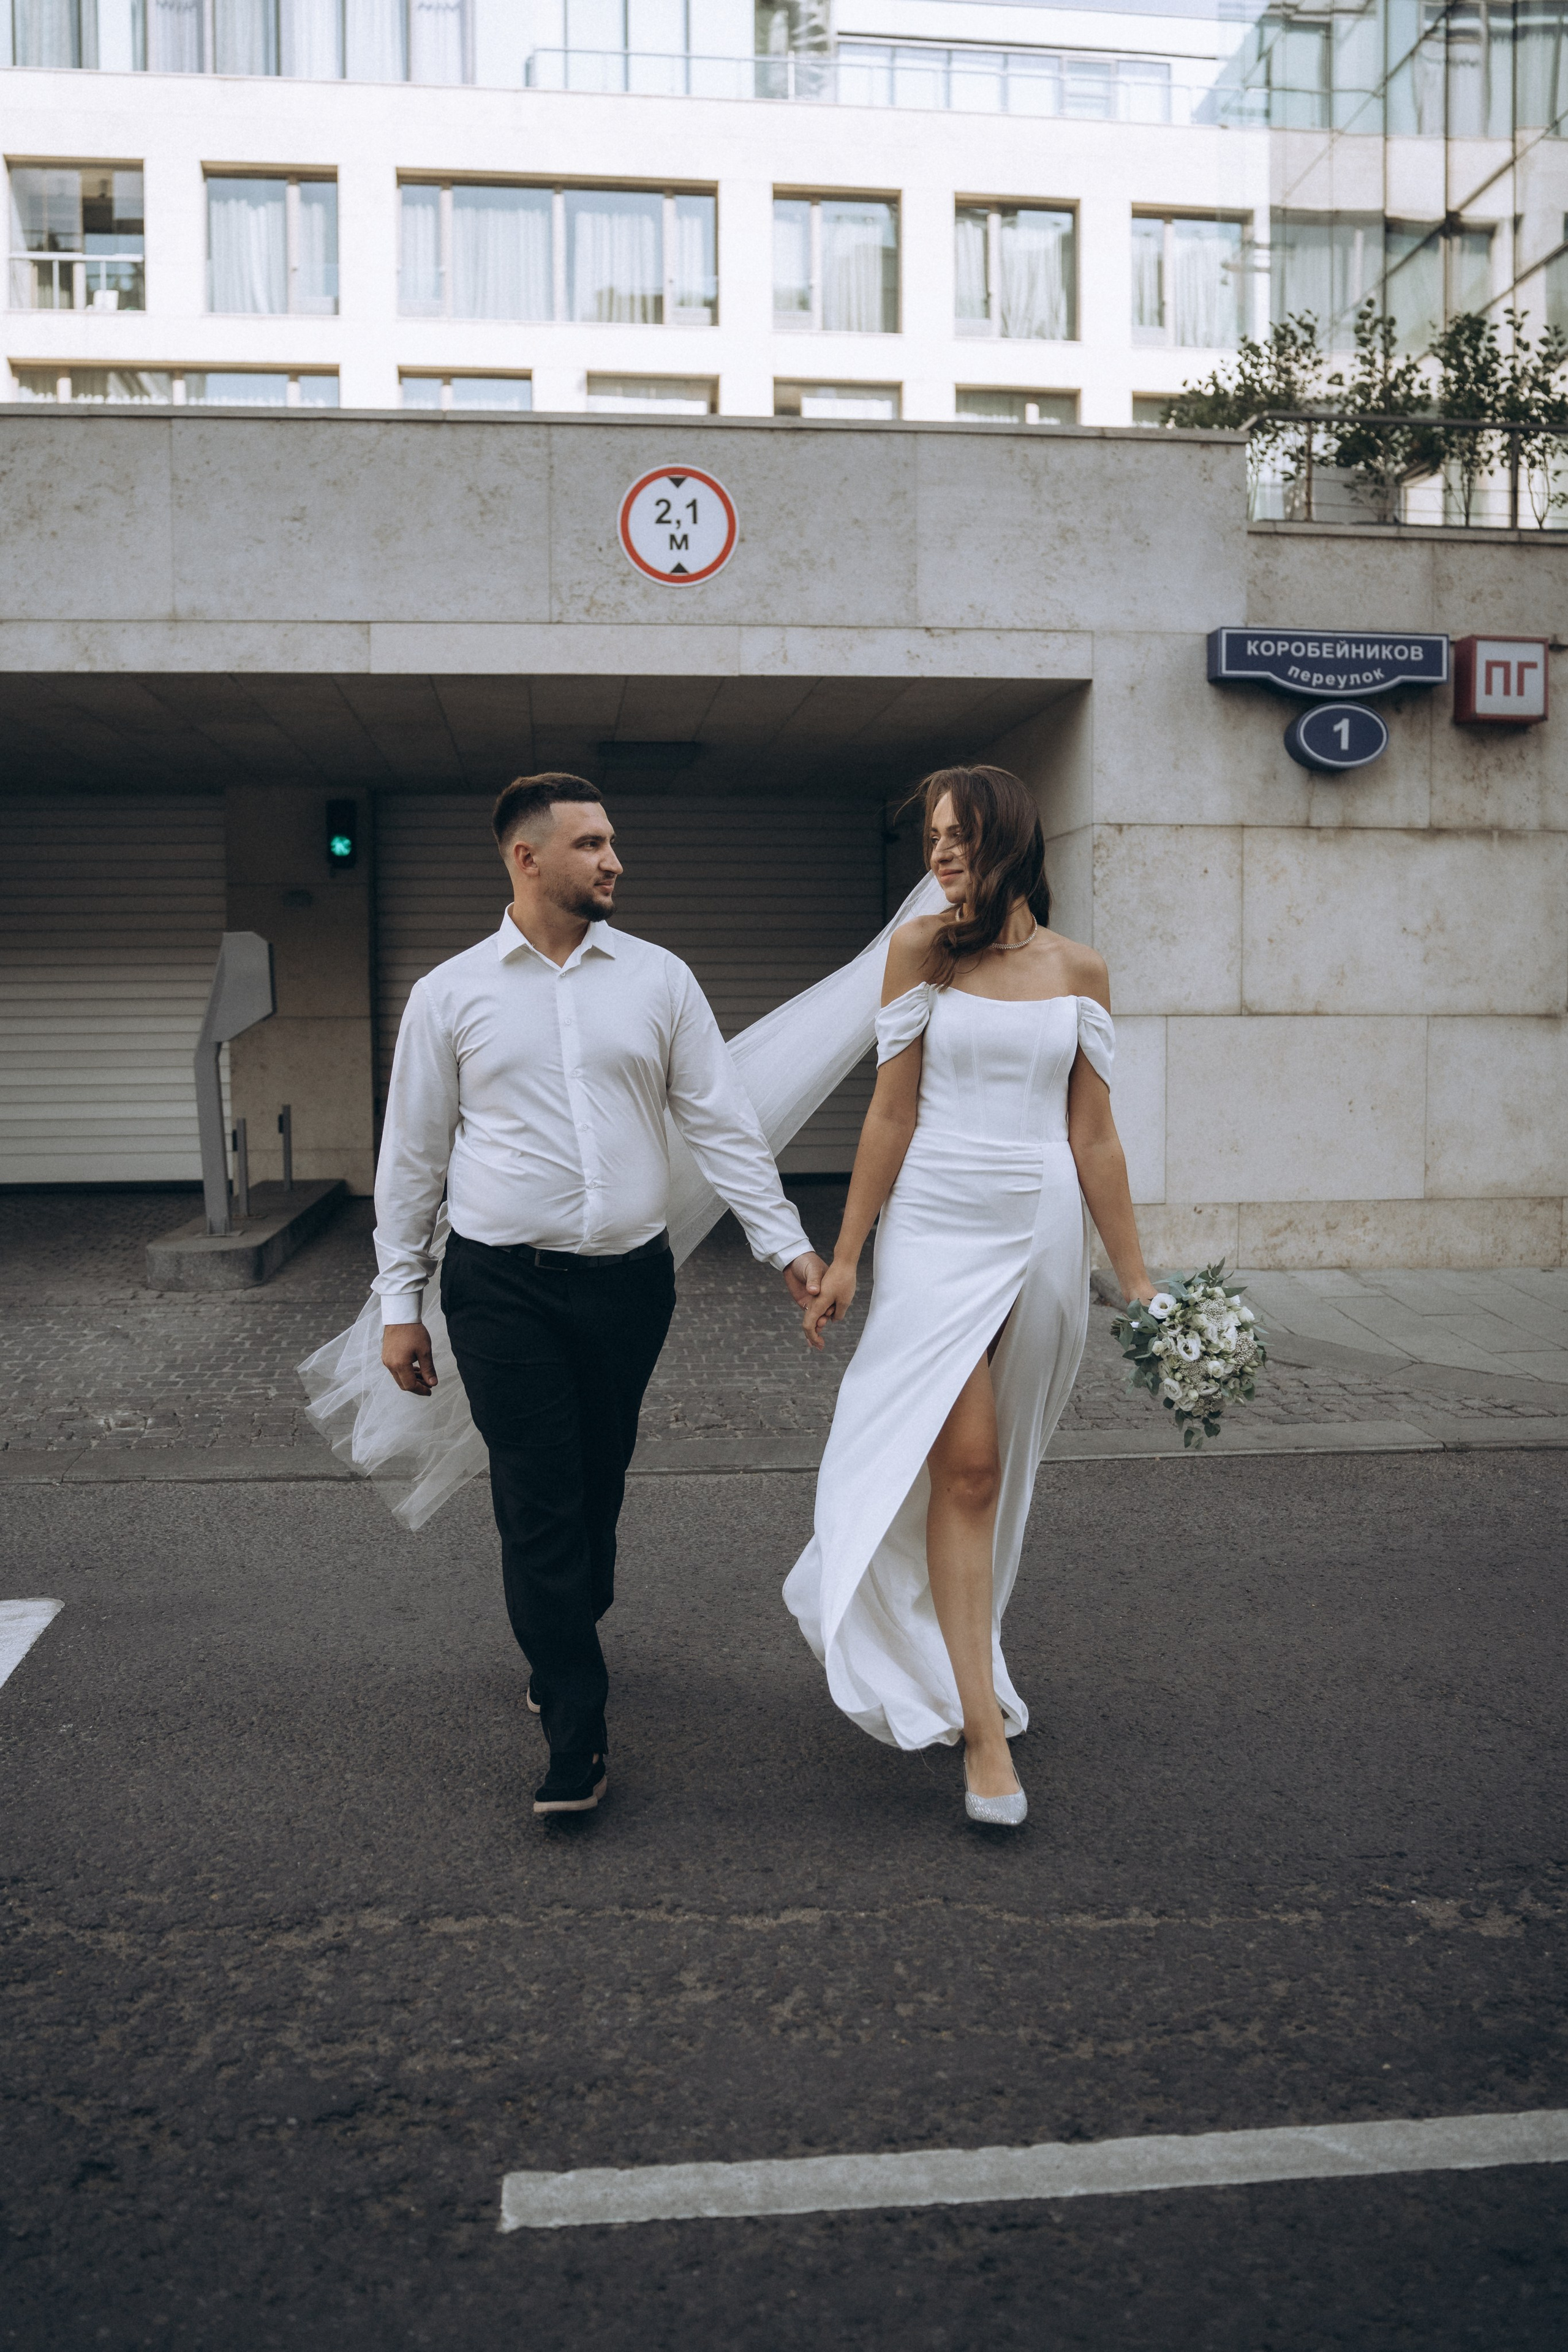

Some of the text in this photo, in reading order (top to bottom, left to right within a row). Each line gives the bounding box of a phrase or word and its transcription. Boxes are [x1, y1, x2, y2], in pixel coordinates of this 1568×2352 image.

[655, 499, 698, 529] 2,1
[1246, 639, 1424, 661] КОРОБЕЙНИКОВ
[1287, 665, 1385, 690] переулок
[1485, 660, 1538, 696] ПГ
[1333, 718, 1350, 750] 1
